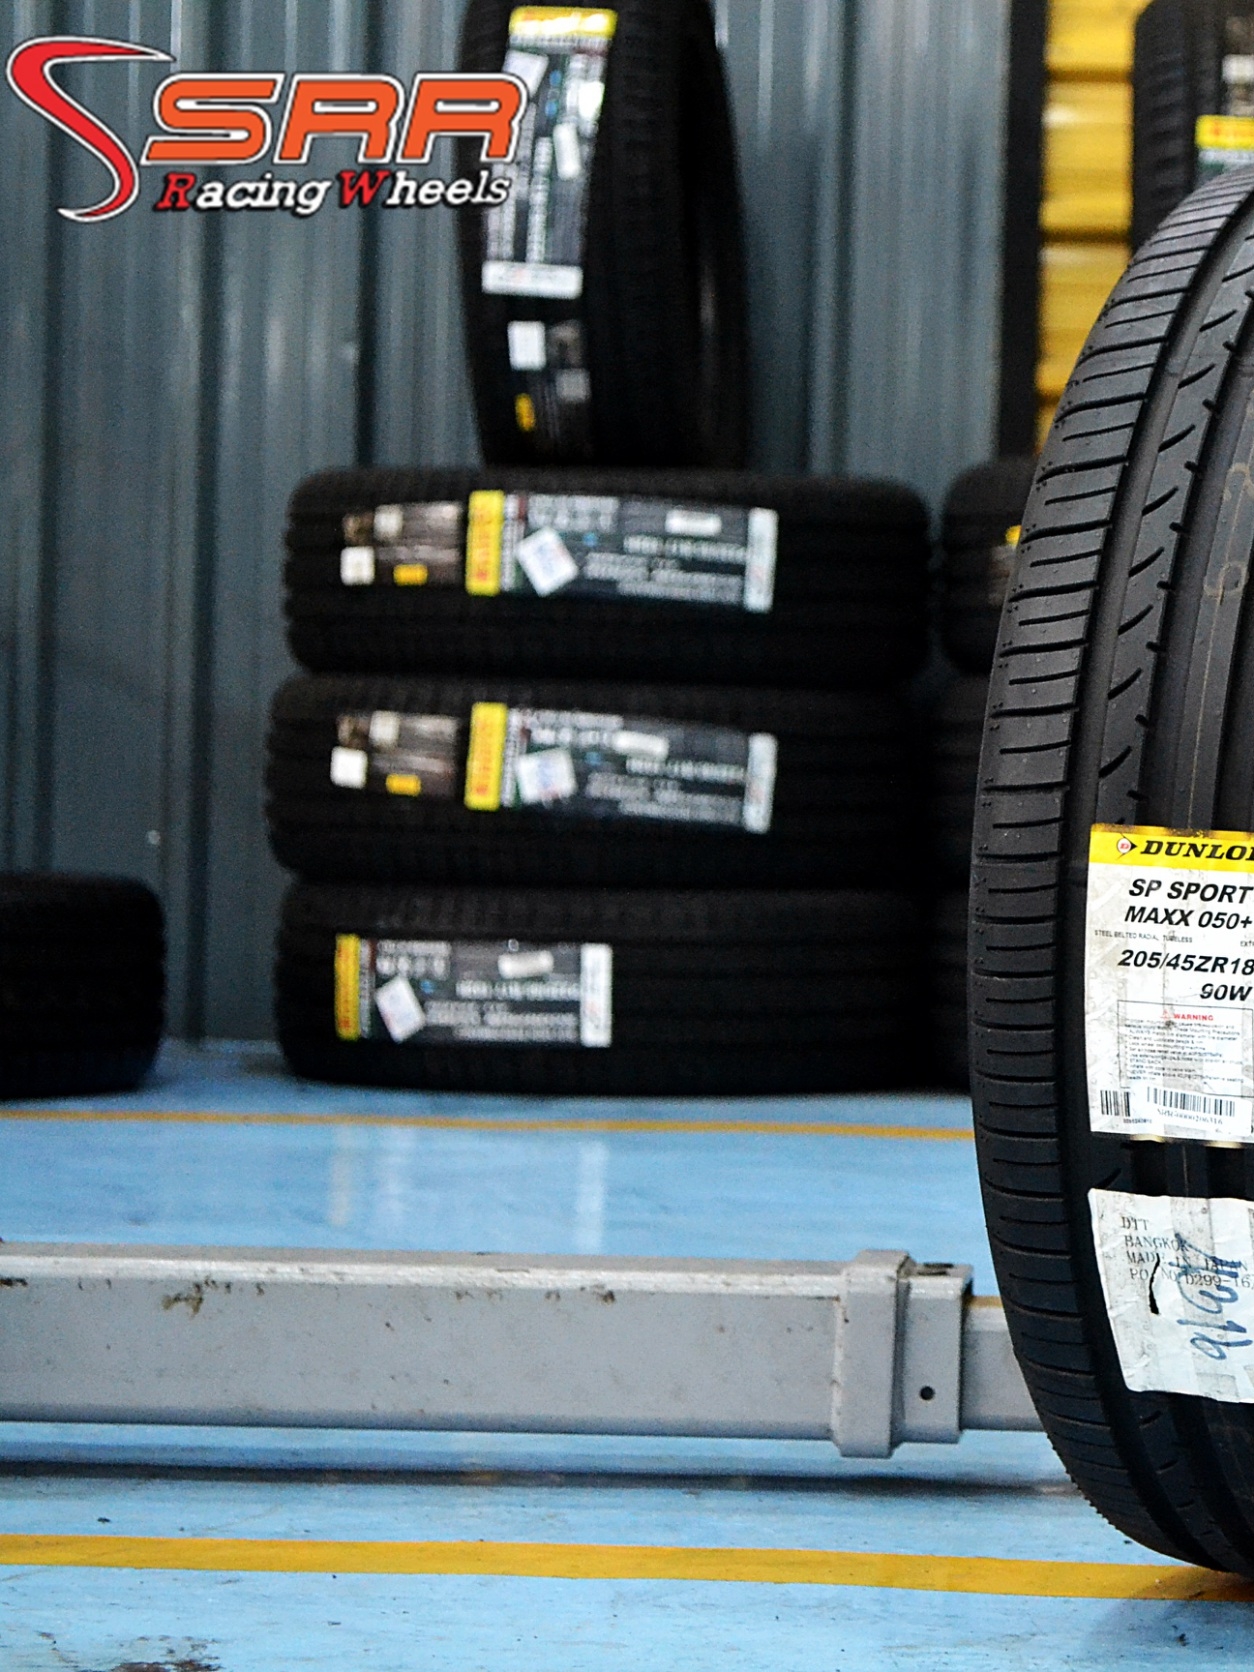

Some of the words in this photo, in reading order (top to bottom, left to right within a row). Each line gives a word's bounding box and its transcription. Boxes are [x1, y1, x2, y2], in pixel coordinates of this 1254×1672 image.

[1128, 878, 1162, 898] SP
[1167, 880, 1254, 904] SPORT
[1124, 905, 1194, 927] MAXX
[1198, 910, 1253, 930] 050+
[1094, 929, 1113, 938] STEEL
[1199, 983, 1254, 1002] 90W
[1173, 1013, 1214, 1021] WARNING
[1124, 1234, 1190, 1252] BANGKOK
